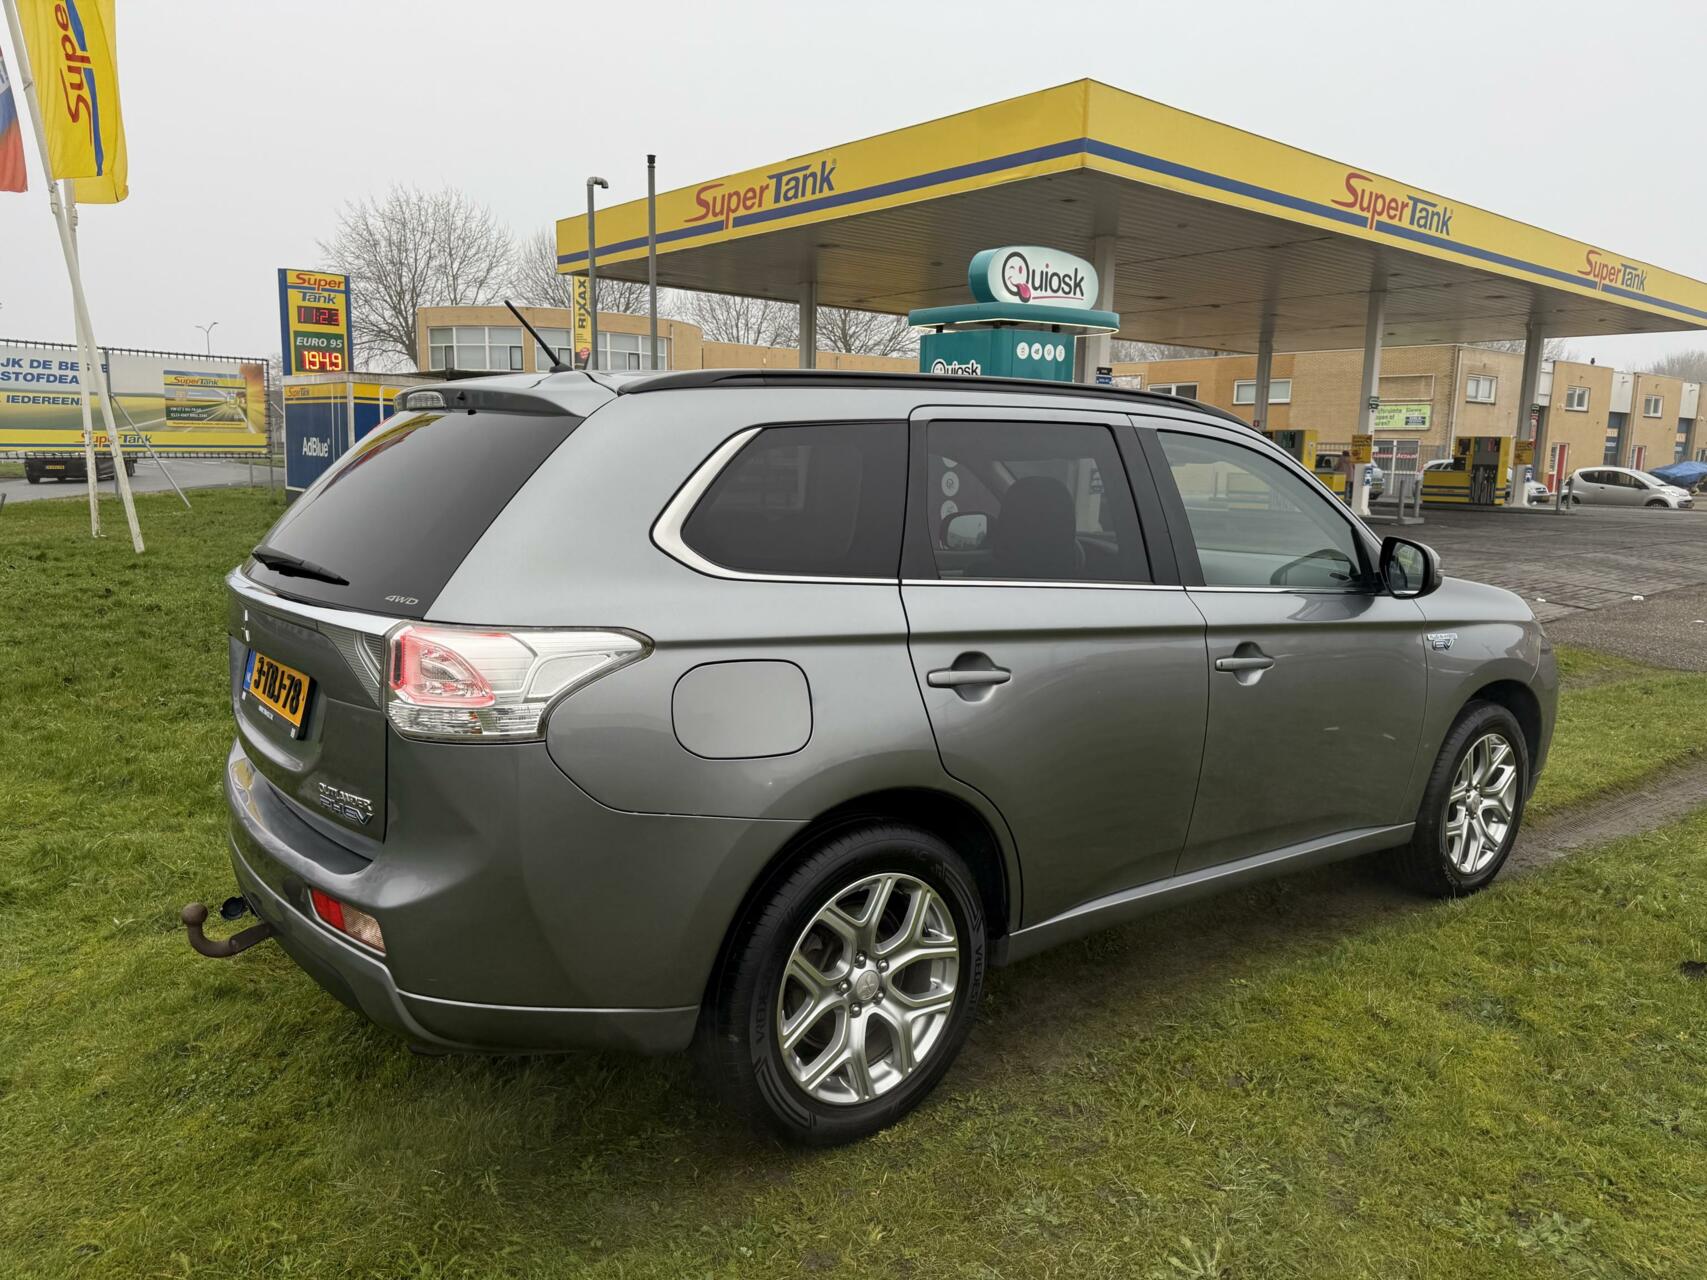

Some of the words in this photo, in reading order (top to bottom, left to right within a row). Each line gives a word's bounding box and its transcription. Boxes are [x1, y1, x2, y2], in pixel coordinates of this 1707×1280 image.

[55, 3, 92, 147] Supe
[288, 273, 344, 291] Super
[1002, 251, 1085, 303] Quiosk
[297, 290, 337, 304] Tank
[296, 337, 327, 348] EURO
[329, 339, 343, 349] 95
[0, 358, 23, 369] JK
[29, 359, 52, 370] DE
[58, 361, 108, 374] BEE
[303, 351, 342, 371] 194.9
[0, 371, 80, 384] STOFDEA
[384, 595, 420, 606] 4WD
